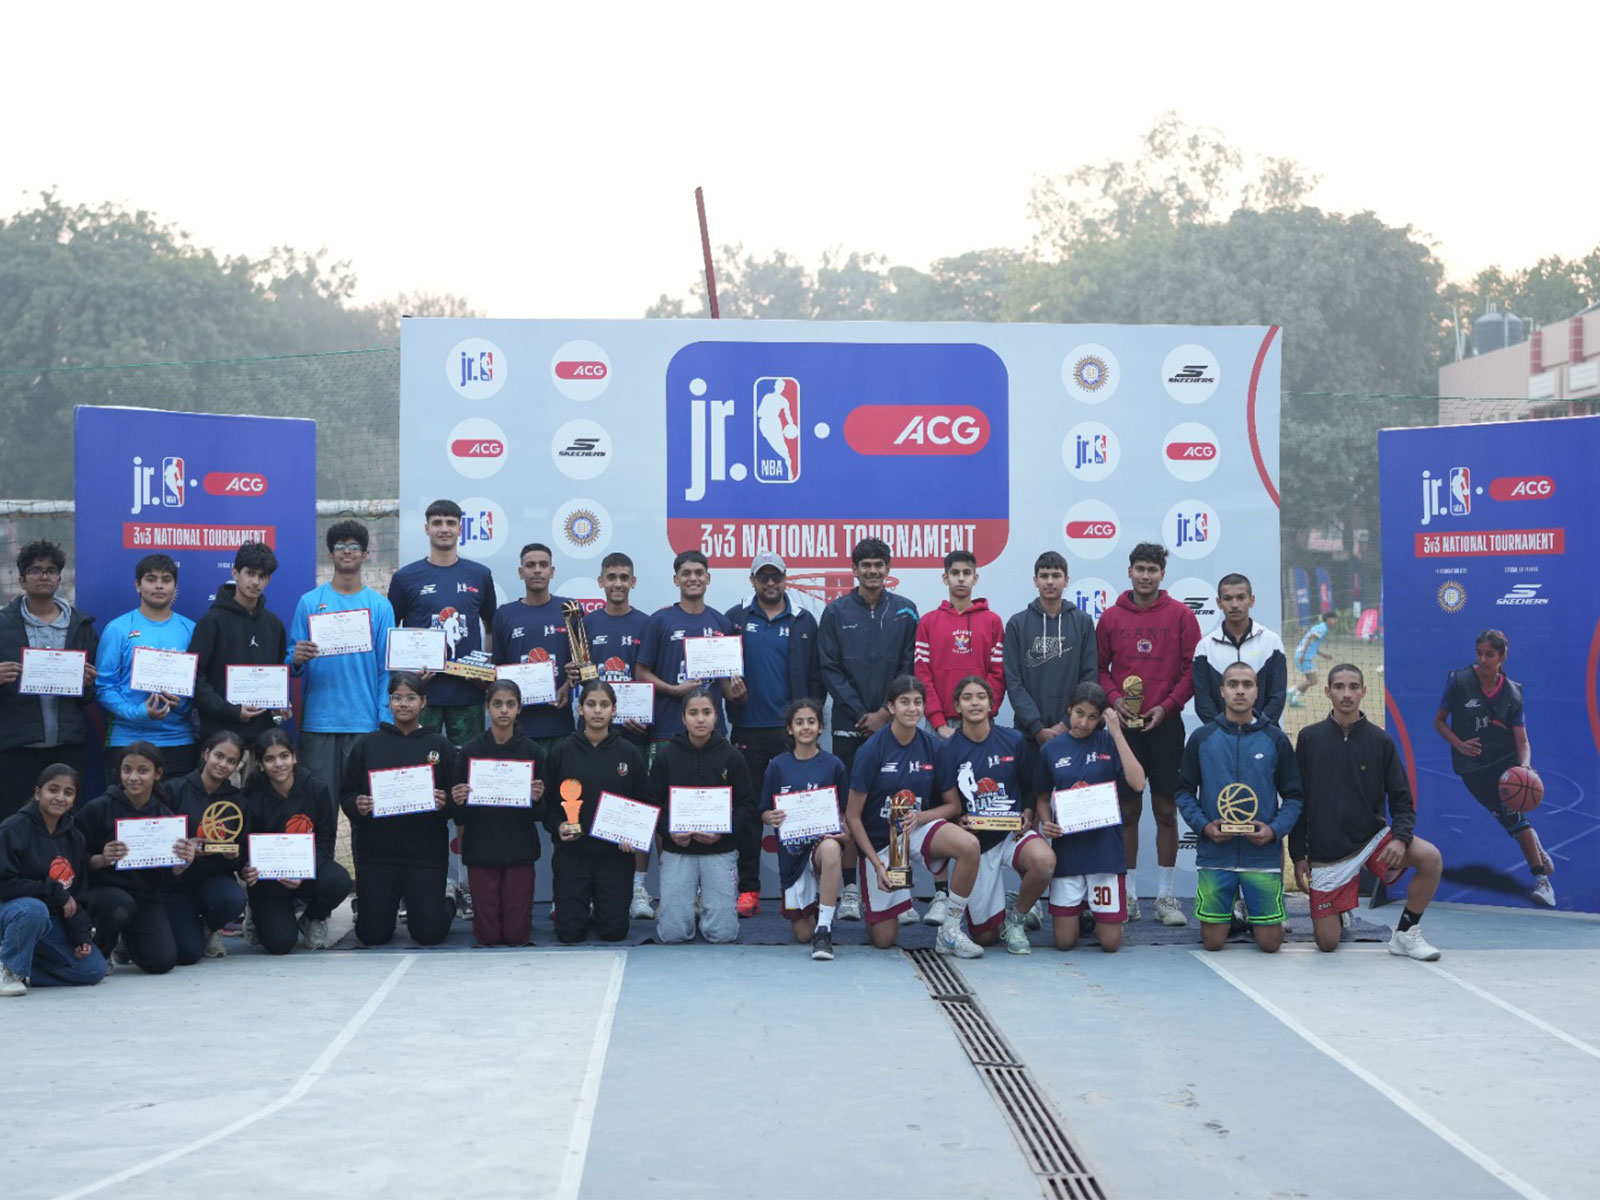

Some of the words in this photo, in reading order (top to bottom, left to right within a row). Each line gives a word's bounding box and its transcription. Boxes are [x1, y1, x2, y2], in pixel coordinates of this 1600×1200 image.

[460, 352, 479, 387] jr.
[573, 365, 604, 376] ACG
[469, 443, 501, 454] ACG
[685, 378, 748, 502] jr.
[761, 459, 784, 477] NBA
[894, 415, 980, 445] ACG
[1075, 435, 1093, 469] jr.
[1183, 446, 1213, 457] ACG
[131, 456, 161, 515] jr.
[225, 477, 264, 492] ACG
[1421, 470, 1448, 525] jr.
[1511, 480, 1551, 496] ACG
[133, 526, 152, 545] 3v3
[154, 527, 201, 546] NATIONAL
[203, 528, 267, 547] TOURNAMENT
[700, 523, 736, 558] 3v3
[742, 523, 838, 558] NATIONAL
[1083, 524, 1113, 536] ACG
[1176, 512, 1194, 548] jr.
[1423, 536, 1441, 554] 3v3
[1442, 534, 1489, 553] NATIONAL
[1489, 532, 1555, 552] TOURNAMENT
[1496, 597, 1549, 605] SKECHERS
[1093, 886, 1112, 907] 30
